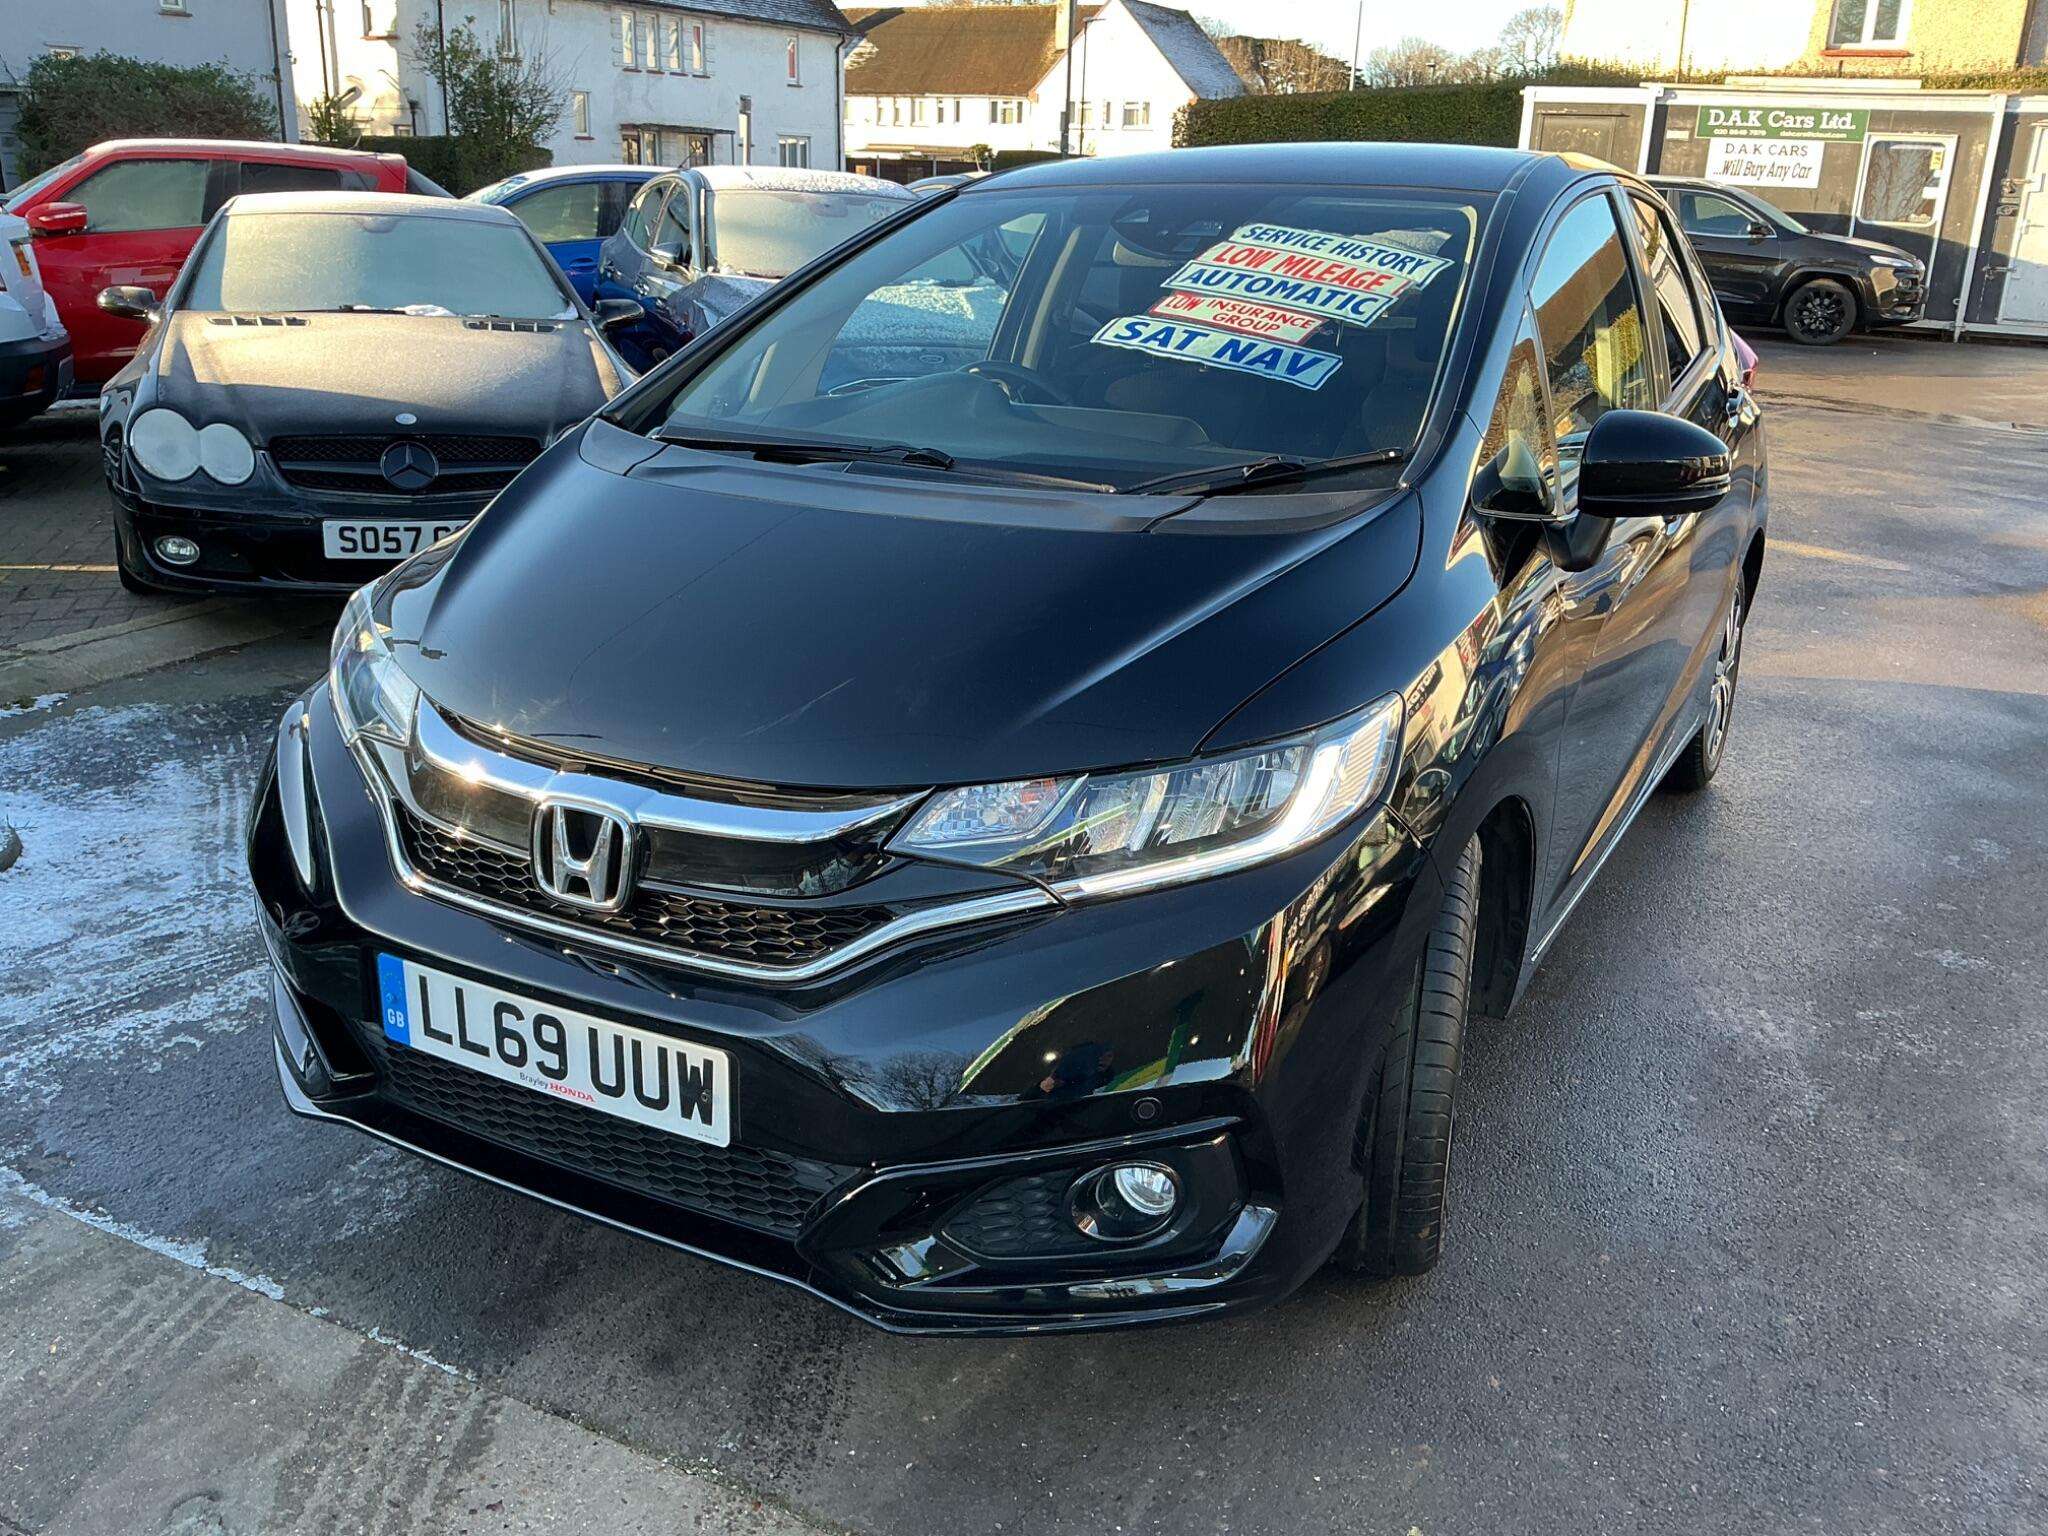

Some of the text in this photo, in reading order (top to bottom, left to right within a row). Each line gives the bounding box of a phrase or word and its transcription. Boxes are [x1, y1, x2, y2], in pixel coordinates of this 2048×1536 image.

[1768, 110, 1815, 128] Cars
[1819, 112, 1856, 130] Ltd.
[1768, 144, 1809, 157] CARS
[1744, 162, 1767, 180] Buy
[1767, 162, 1789, 181] Any
[1791, 162, 1813, 179] Car
[1242, 225, 1428, 275] SERVICE HISTORY
[1213, 244, 1392, 293] LOW MILEAGE
[1180, 267, 1381, 317] AUTOMATIC
[1207, 299, 1316, 330] INSURANCE
[1212, 312, 1281, 332] GROUP
[1113, 320, 1326, 378] SAT NAV
[338, 525, 422, 554] SO57
[387, 1008, 405, 1028] GB
[418, 974, 714, 1126] LL69 UUW
[520, 1072, 596, 1102] Brayley HONDA
